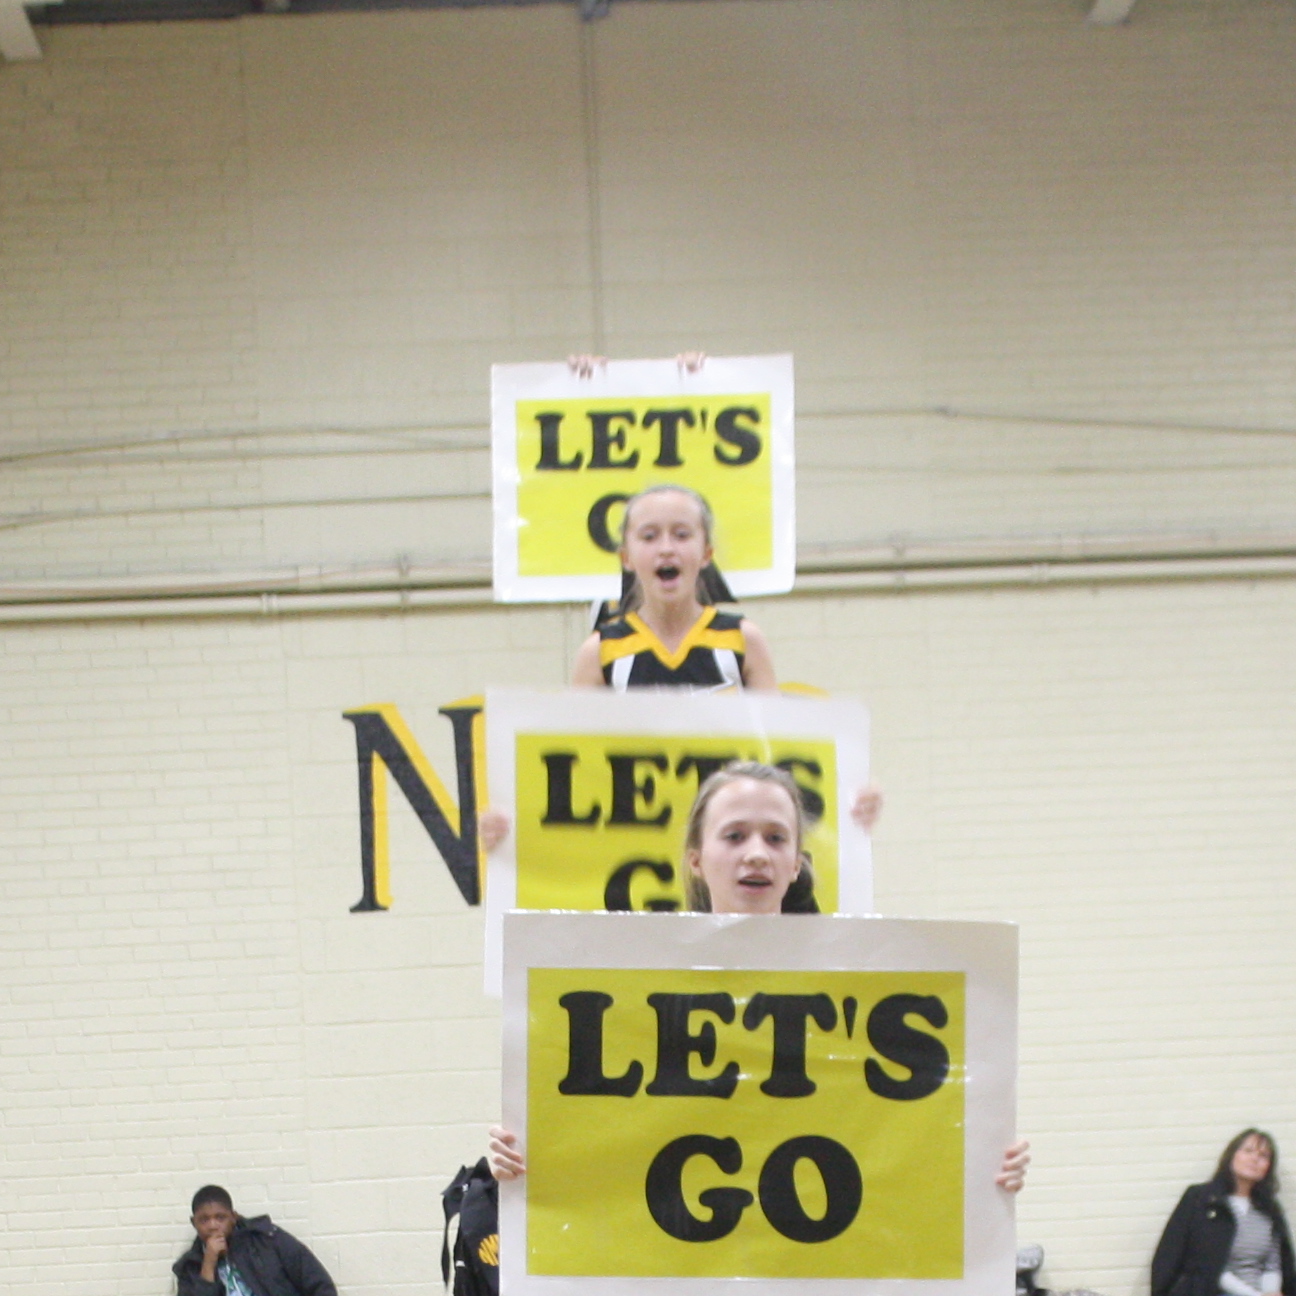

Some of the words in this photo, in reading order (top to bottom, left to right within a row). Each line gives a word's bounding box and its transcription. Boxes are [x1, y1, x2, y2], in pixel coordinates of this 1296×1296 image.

[534, 406, 763, 472] LET'S
[604, 858, 680, 912] G
[558, 991, 951, 1100] LET'S
[645, 1134, 863, 1243] GO
